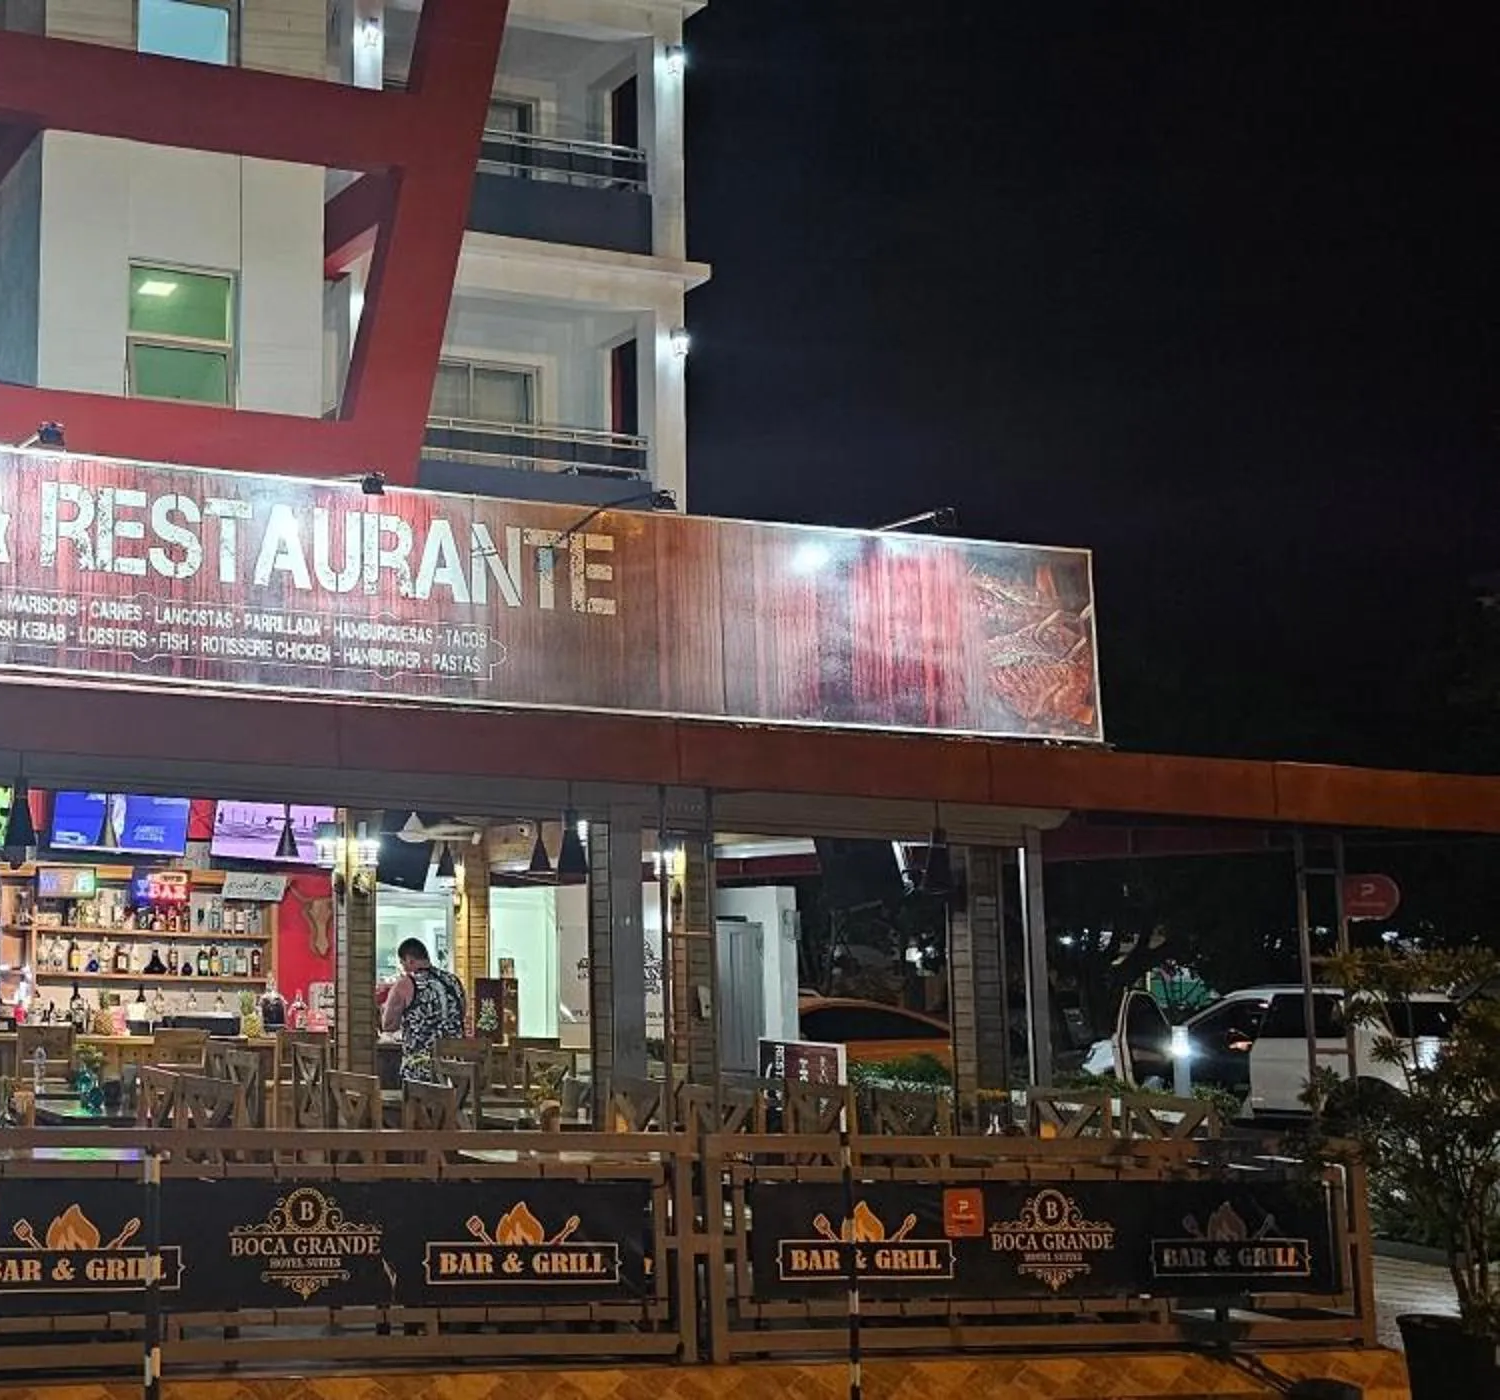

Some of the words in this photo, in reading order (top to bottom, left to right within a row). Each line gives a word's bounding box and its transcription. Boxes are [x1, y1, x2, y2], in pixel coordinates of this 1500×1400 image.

[40, 481, 616, 615] RESTAURANTE
[8, 595, 77, 617] MARISCOS
[91, 602, 142, 620] CARNES
[155, 605, 232, 628] LANGOSTAS
[244, 613, 321, 636] PARRILLADA
[334, 619, 432, 643] HAMBURGUESAS
[445, 628, 487, 649] TACOS
[21, 620, 66, 641] KEBAB
[80, 626, 147, 648] LOBSTERS
[159, 631, 189, 651] FISH
[202, 635, 272, 657] ROTISSERIE
[276, 641, 330, 662] CHICKEN
[344, 647, 421, 669] HAMBURGER
[433, 654, 481, 673] PASTAS
[230, 1236, 287, 1256] BOCA
[293, 1236, 381, 1255] GRANDE
[992, 1233, 1038, 1251] BOCA
[1042, 1233, 1114, 1251] GRANDE
[439, 1253, 493, 1274] BAR
[502, 1253, 522, 1274] &
[533, 1253, 606, 1274] GRILL
[791, 1250, 841, 1270] BAR
[875, 1250, 942, 1270] GRILL
[1163, 1248, 1207, 1268] BAR
[1213, 1248, 1232, 1268] &
[1238, 1247, 1299, 1267] GRILL
[52, 1258, 75, 1281] &
